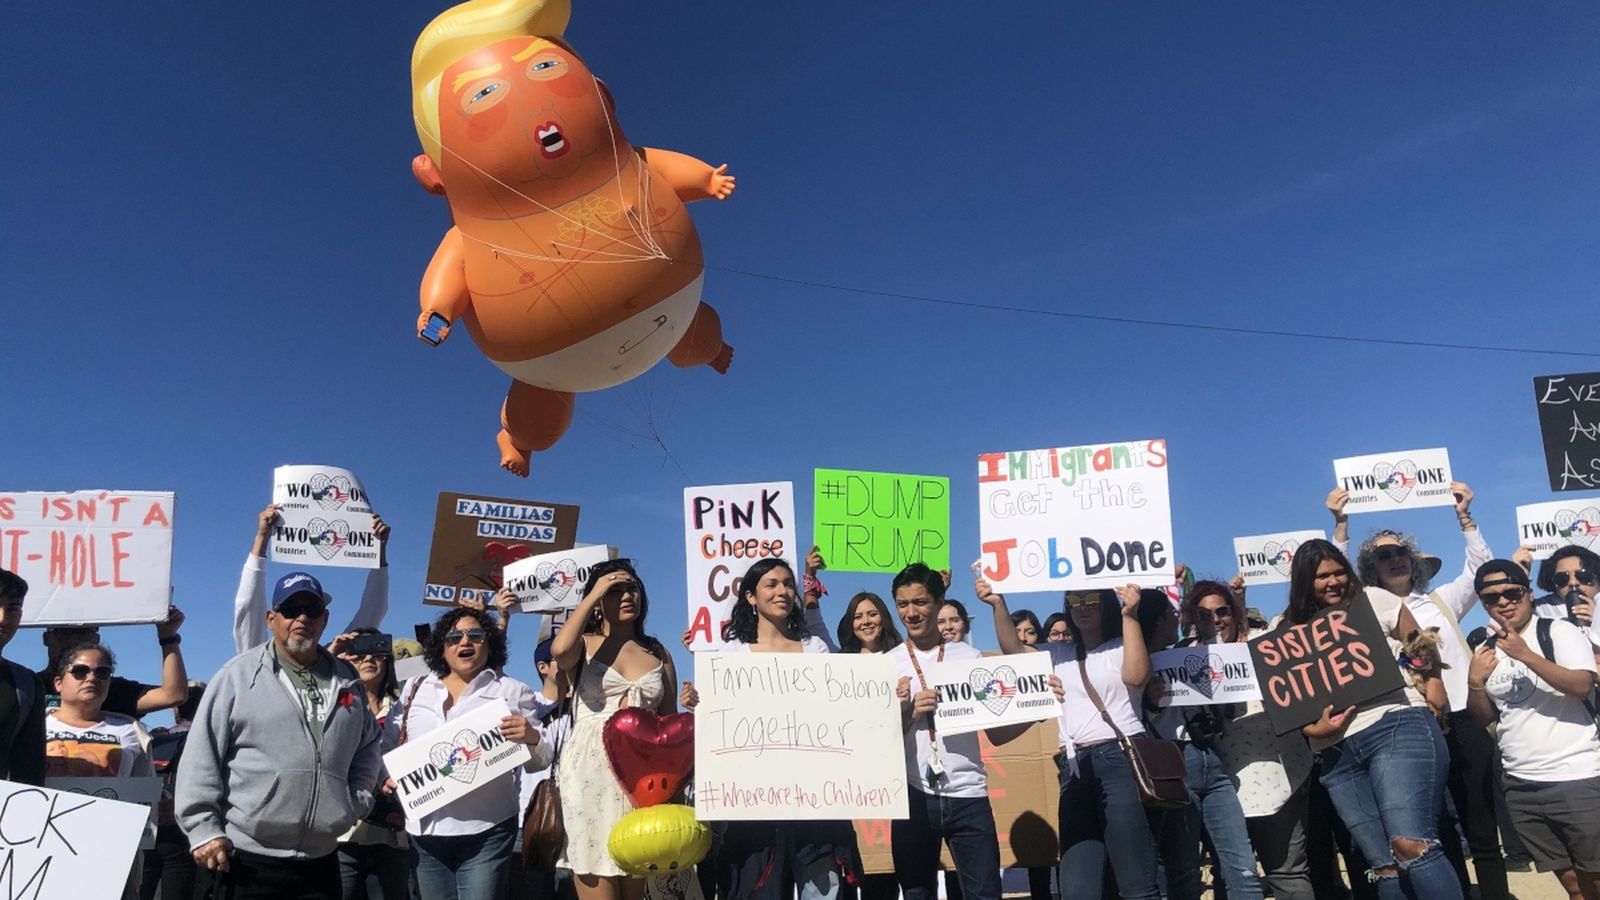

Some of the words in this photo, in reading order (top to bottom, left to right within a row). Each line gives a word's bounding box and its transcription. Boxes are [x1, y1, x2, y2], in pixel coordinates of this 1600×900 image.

[1340, 474, 1375, 491] TWO
[1417, 467, 1446, 485] ONE
[278, 483, 311, 498] WO
[350, 487, 371, 504] ON
[820, 475, 944, 520] #DUMP
[989, 483, 1053, 519] Get
[1073, 478, 1148, 510] the
[1347, 495, 1378, 503] ountries
[41, 492, 130, 523] ISN'T
[143, 502, 169, 527] A
[458, 501, 553, 521] FAMILIAS
[275, 526, 308, 544] TWO
[349, 530, 374, 548] ONE
[479, 522, 554, 540] UNIDAS
[1521, 521, 1557, 539] TWO
[275, 546, 307, 556] Countries
[344, 550, 377, 560] Community
[701, 532, 783, 559] Cheese
[821, 523, 944, 568] TRUMP
[1080, 537, 1167, 576] Done
[1238, 552, 1266, 567] TWO
[427, 585, 454, 600] NO
[507, 575, 537, 592] TWO
[1257, 610, 1359, 666] SISTER
[710, 656, 817, 696] Families
[824, 663, 892, 708] Belong
[1158, 666, 1188, 684] TWO
[1224, 662, 1250, 680] ONE
[1267, 641, 1375, 708] CITIES
[935, 682, 972, 703] TWO
[1017, 674, 1049, 694] ONE
[1223, 684, 1255, 693] Community
[938, 706, 974, 718] Countries
[1016, 698, 1055, 708] Community
[710, 708, 854, 757] Together
[397, 763, 438, 796] TWO
[484, 744, 522, 768] Community
[408, 785, 446, 810] Countries
